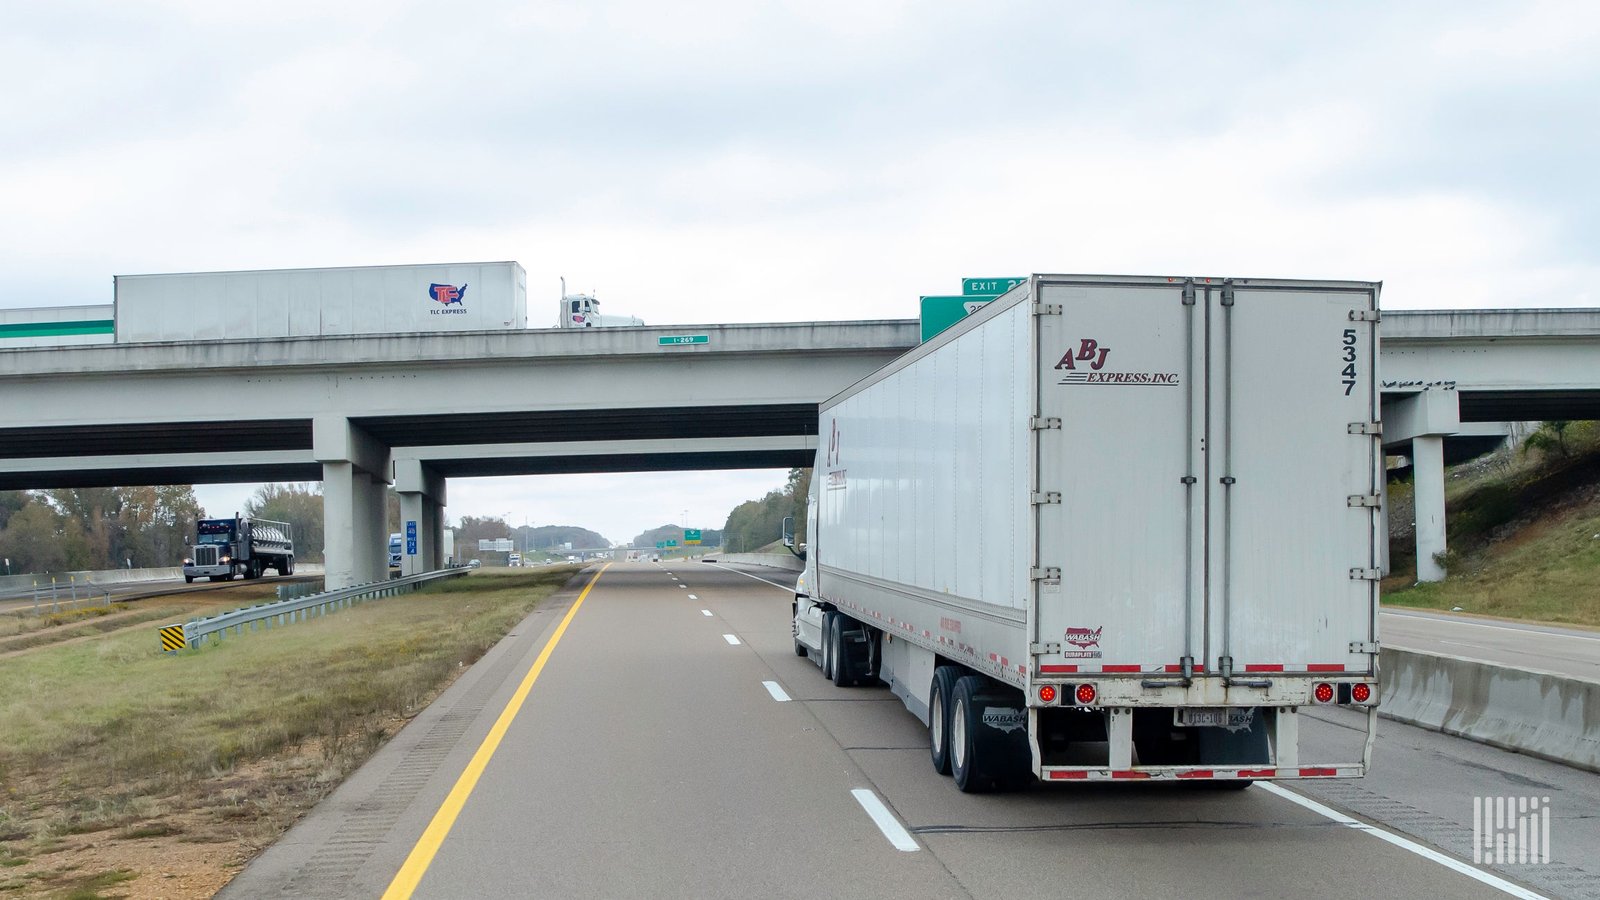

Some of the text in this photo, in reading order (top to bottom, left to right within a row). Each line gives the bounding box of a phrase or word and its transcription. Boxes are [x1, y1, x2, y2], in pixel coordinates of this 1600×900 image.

[971, 282, 998, 291] EXIT
[1054, 338, 1111, 370] ABJ
[1341, 329, 1357, 396] 5347
[983, 714, 1026, 723] WABASH
